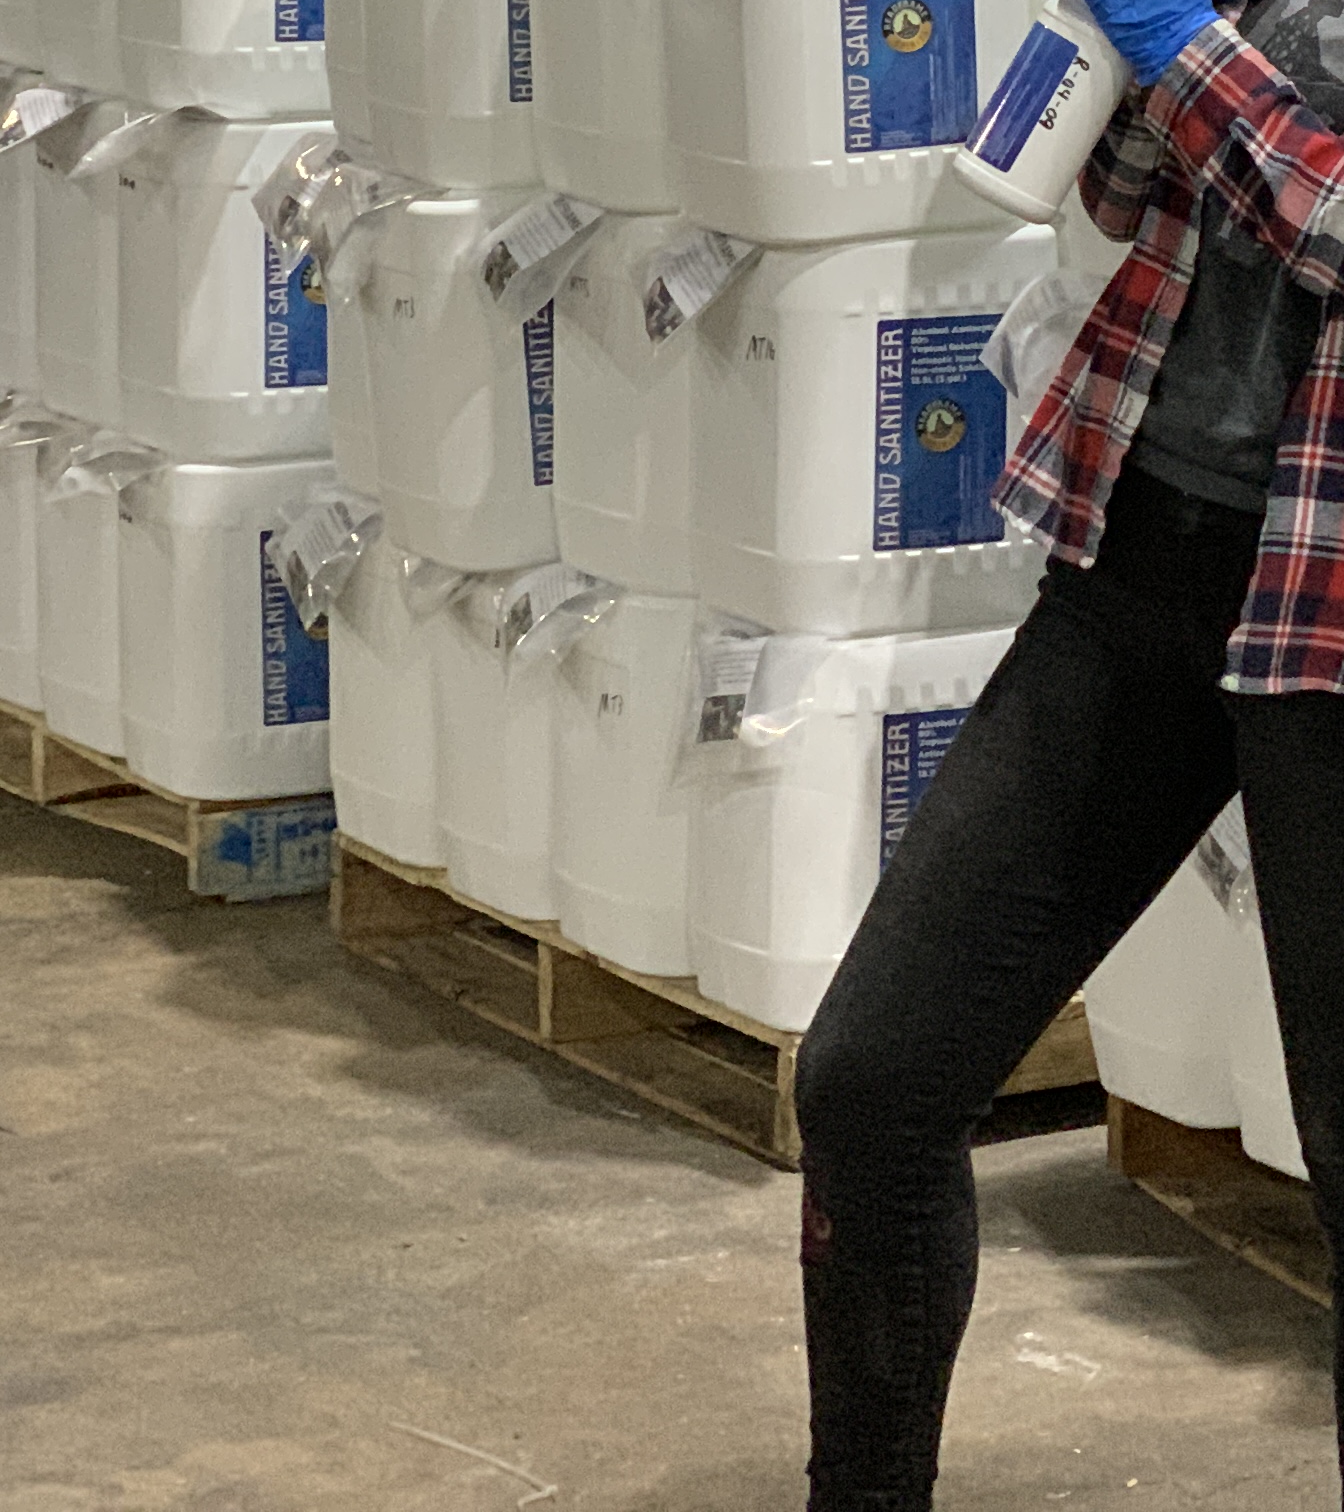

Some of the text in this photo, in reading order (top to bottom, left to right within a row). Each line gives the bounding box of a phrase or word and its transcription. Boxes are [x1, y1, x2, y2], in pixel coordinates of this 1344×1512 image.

[512, 29, 533, 102] HAND
[847, 74, 872, 150] HAND
[268, 239, 289, 386] HAND SANIT
[535, 413, 554, 484] HAND
[878, 328, 904, 547] HAND SANITIZER
[267, 660, 288, 723] HAND
